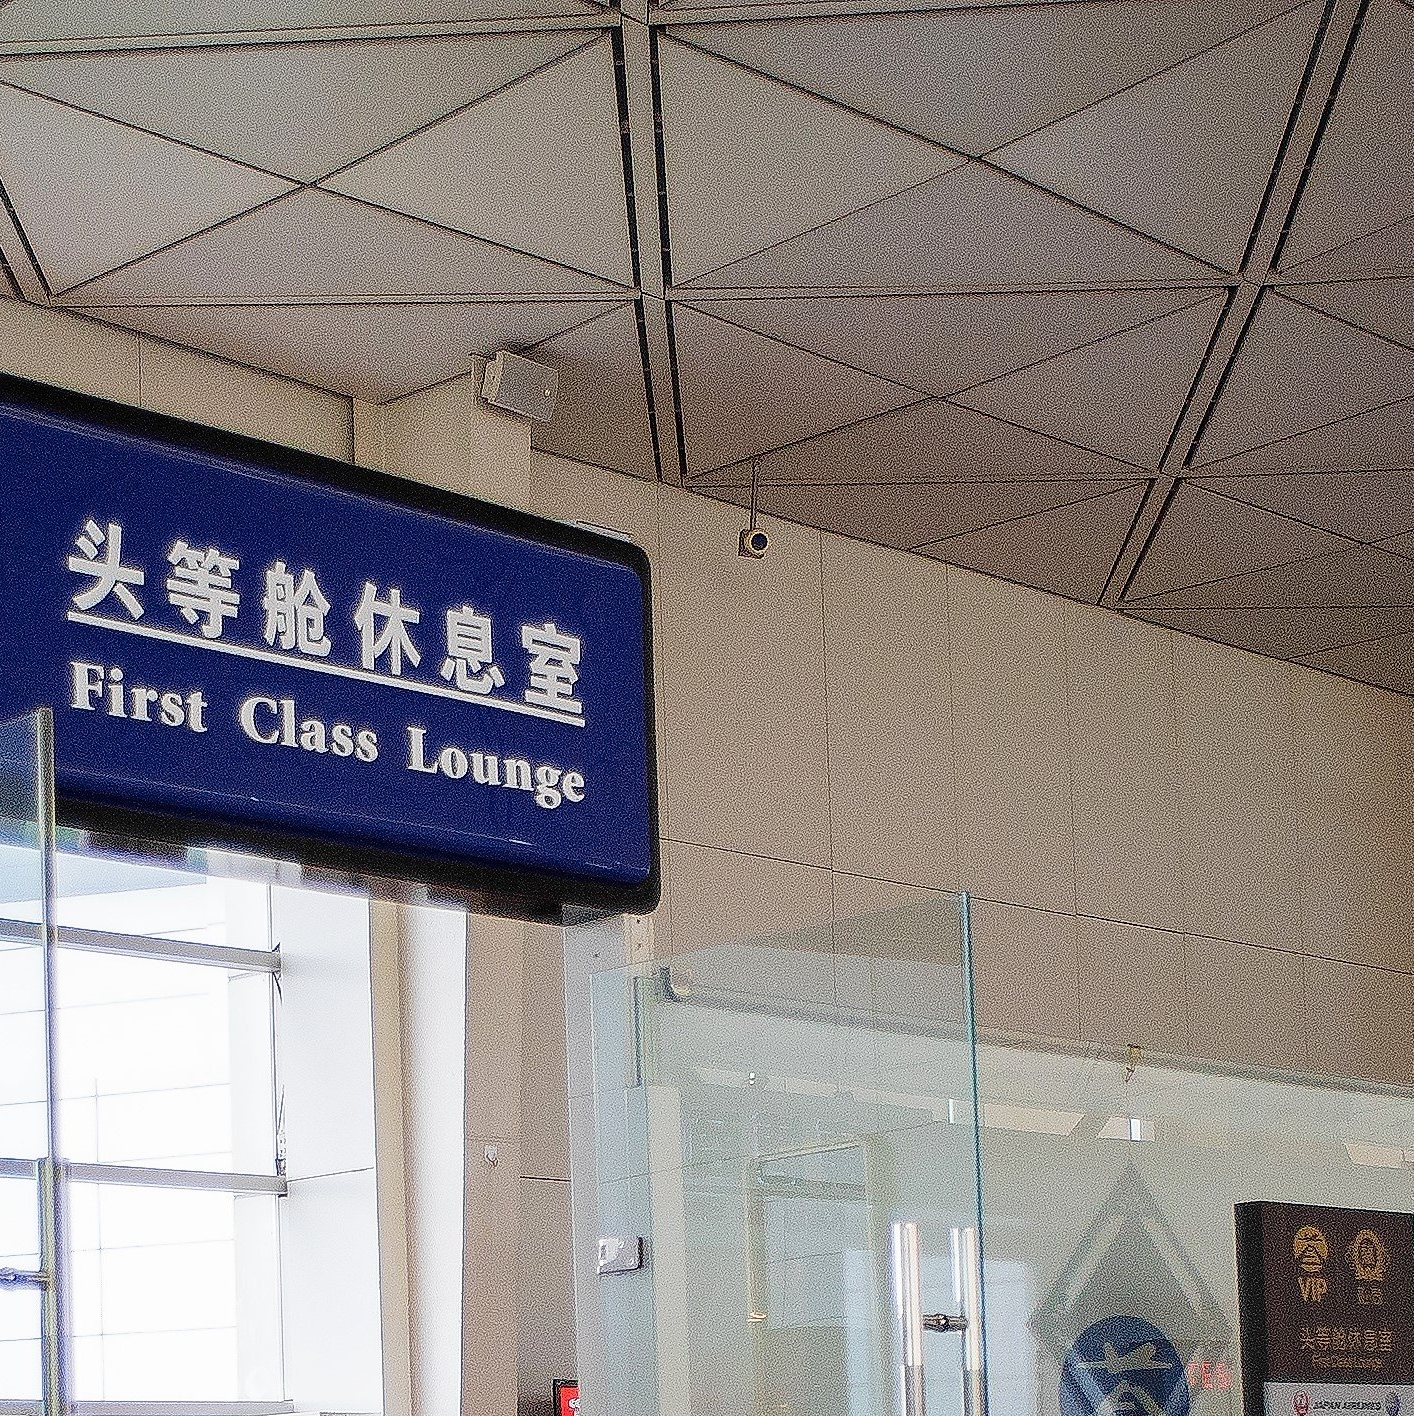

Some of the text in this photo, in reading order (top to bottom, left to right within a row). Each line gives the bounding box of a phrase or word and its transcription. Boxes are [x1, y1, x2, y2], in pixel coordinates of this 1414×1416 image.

[67, 519, 583, 716] 头等舱休息室
[69, 660, 586, 811] First Class Lounge
[1298, 1276, 1328, 1303] VIP
[1313, 1400, 1381, 1411] JAPAN AIRLINES
